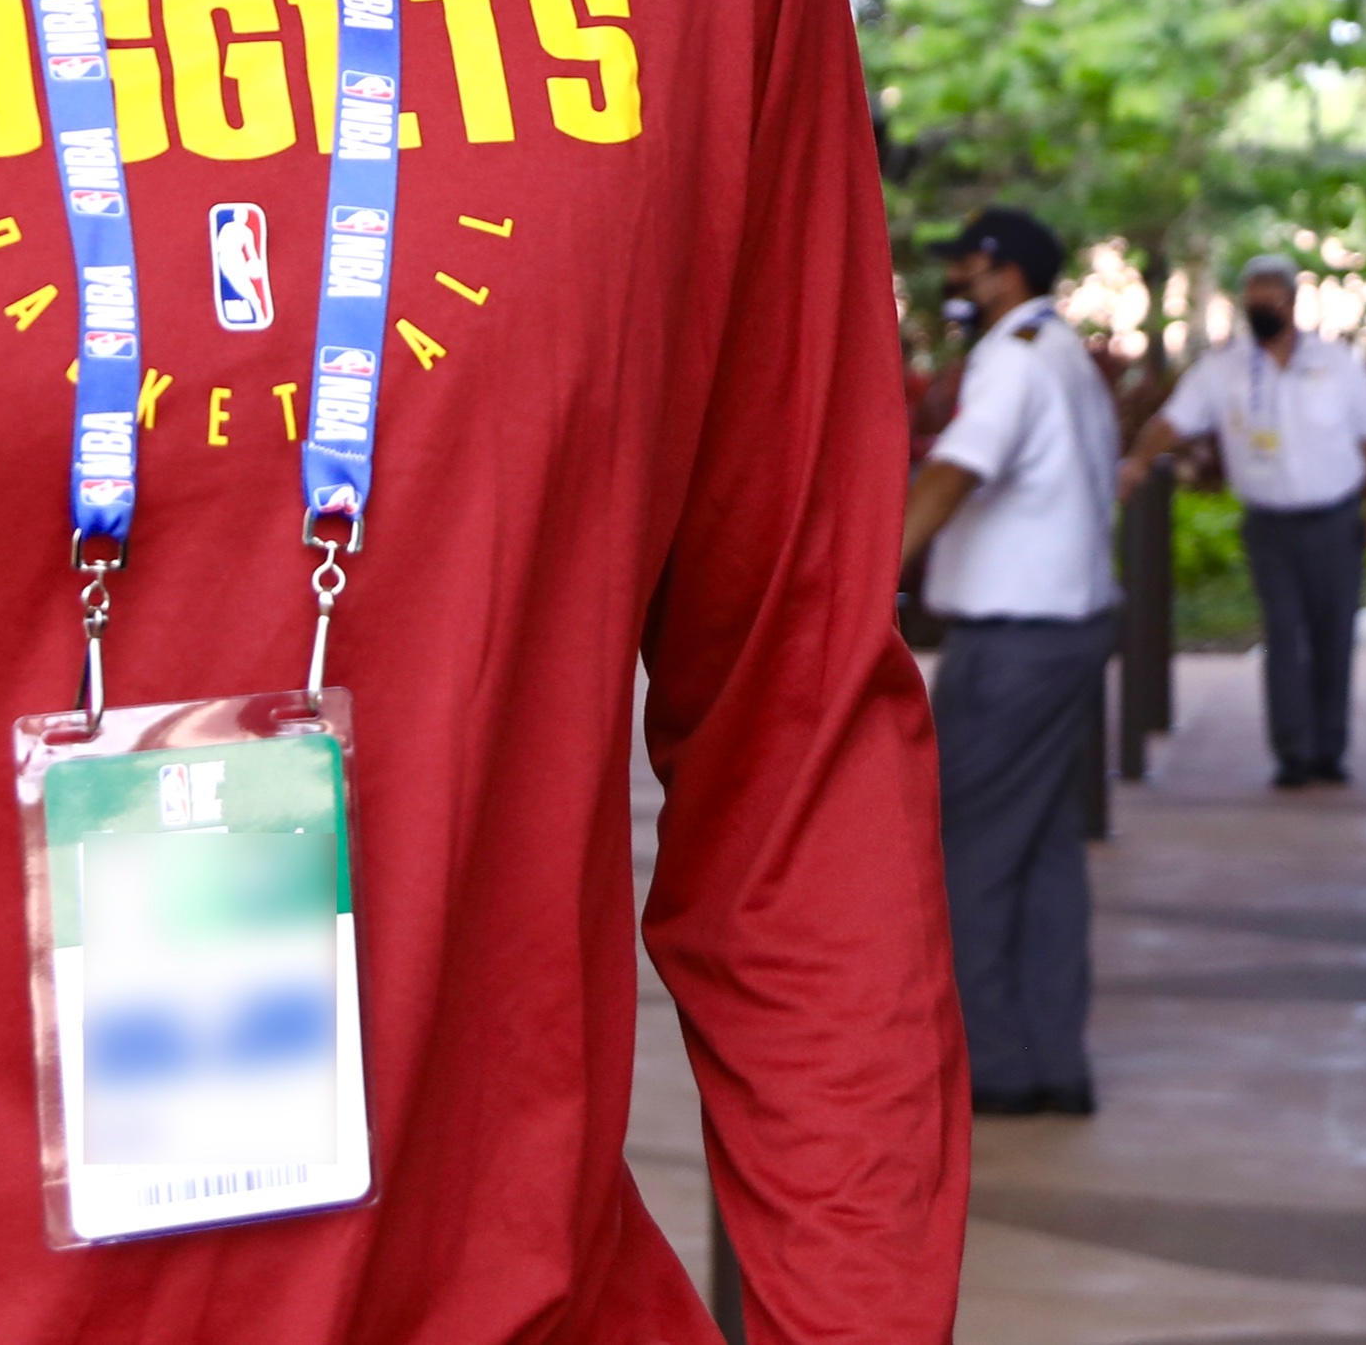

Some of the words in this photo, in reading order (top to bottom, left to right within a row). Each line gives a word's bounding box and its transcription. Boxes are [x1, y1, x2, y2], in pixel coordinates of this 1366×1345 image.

[62, 127, 120, 189] NBA
[338, 98, 394, 160] NBA
[84, 265, 135, 330] NBA
[326, 234, 387, 298] NBA
[314, 375, 373, 442] NBA
[80, 411, 134, 477] NBA
